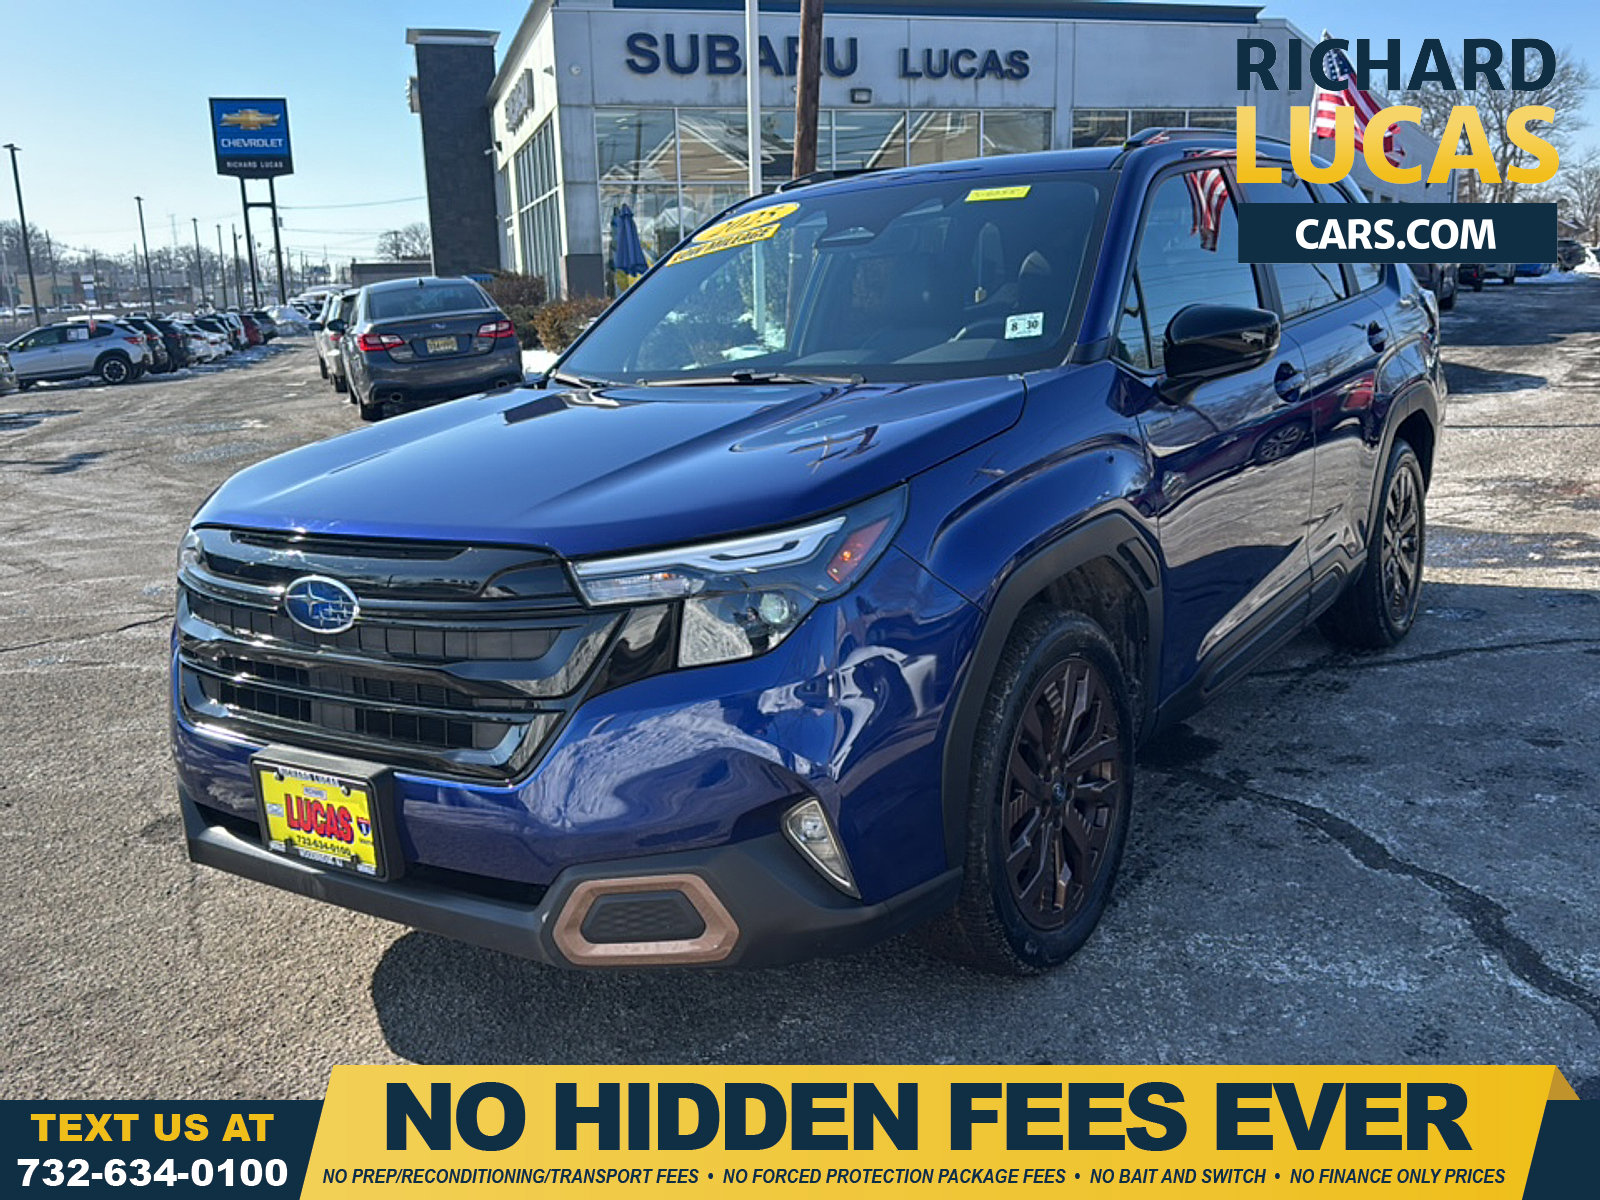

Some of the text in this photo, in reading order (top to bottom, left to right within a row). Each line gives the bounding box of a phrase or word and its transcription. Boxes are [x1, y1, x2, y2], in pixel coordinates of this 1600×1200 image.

[901, 48, 1030, 79] LUCAS
[221, 138, 283, 148] CHEVROLET
[1027, 320, 1039, 330] 30
[284, 793, 354, 845] LUCAS
